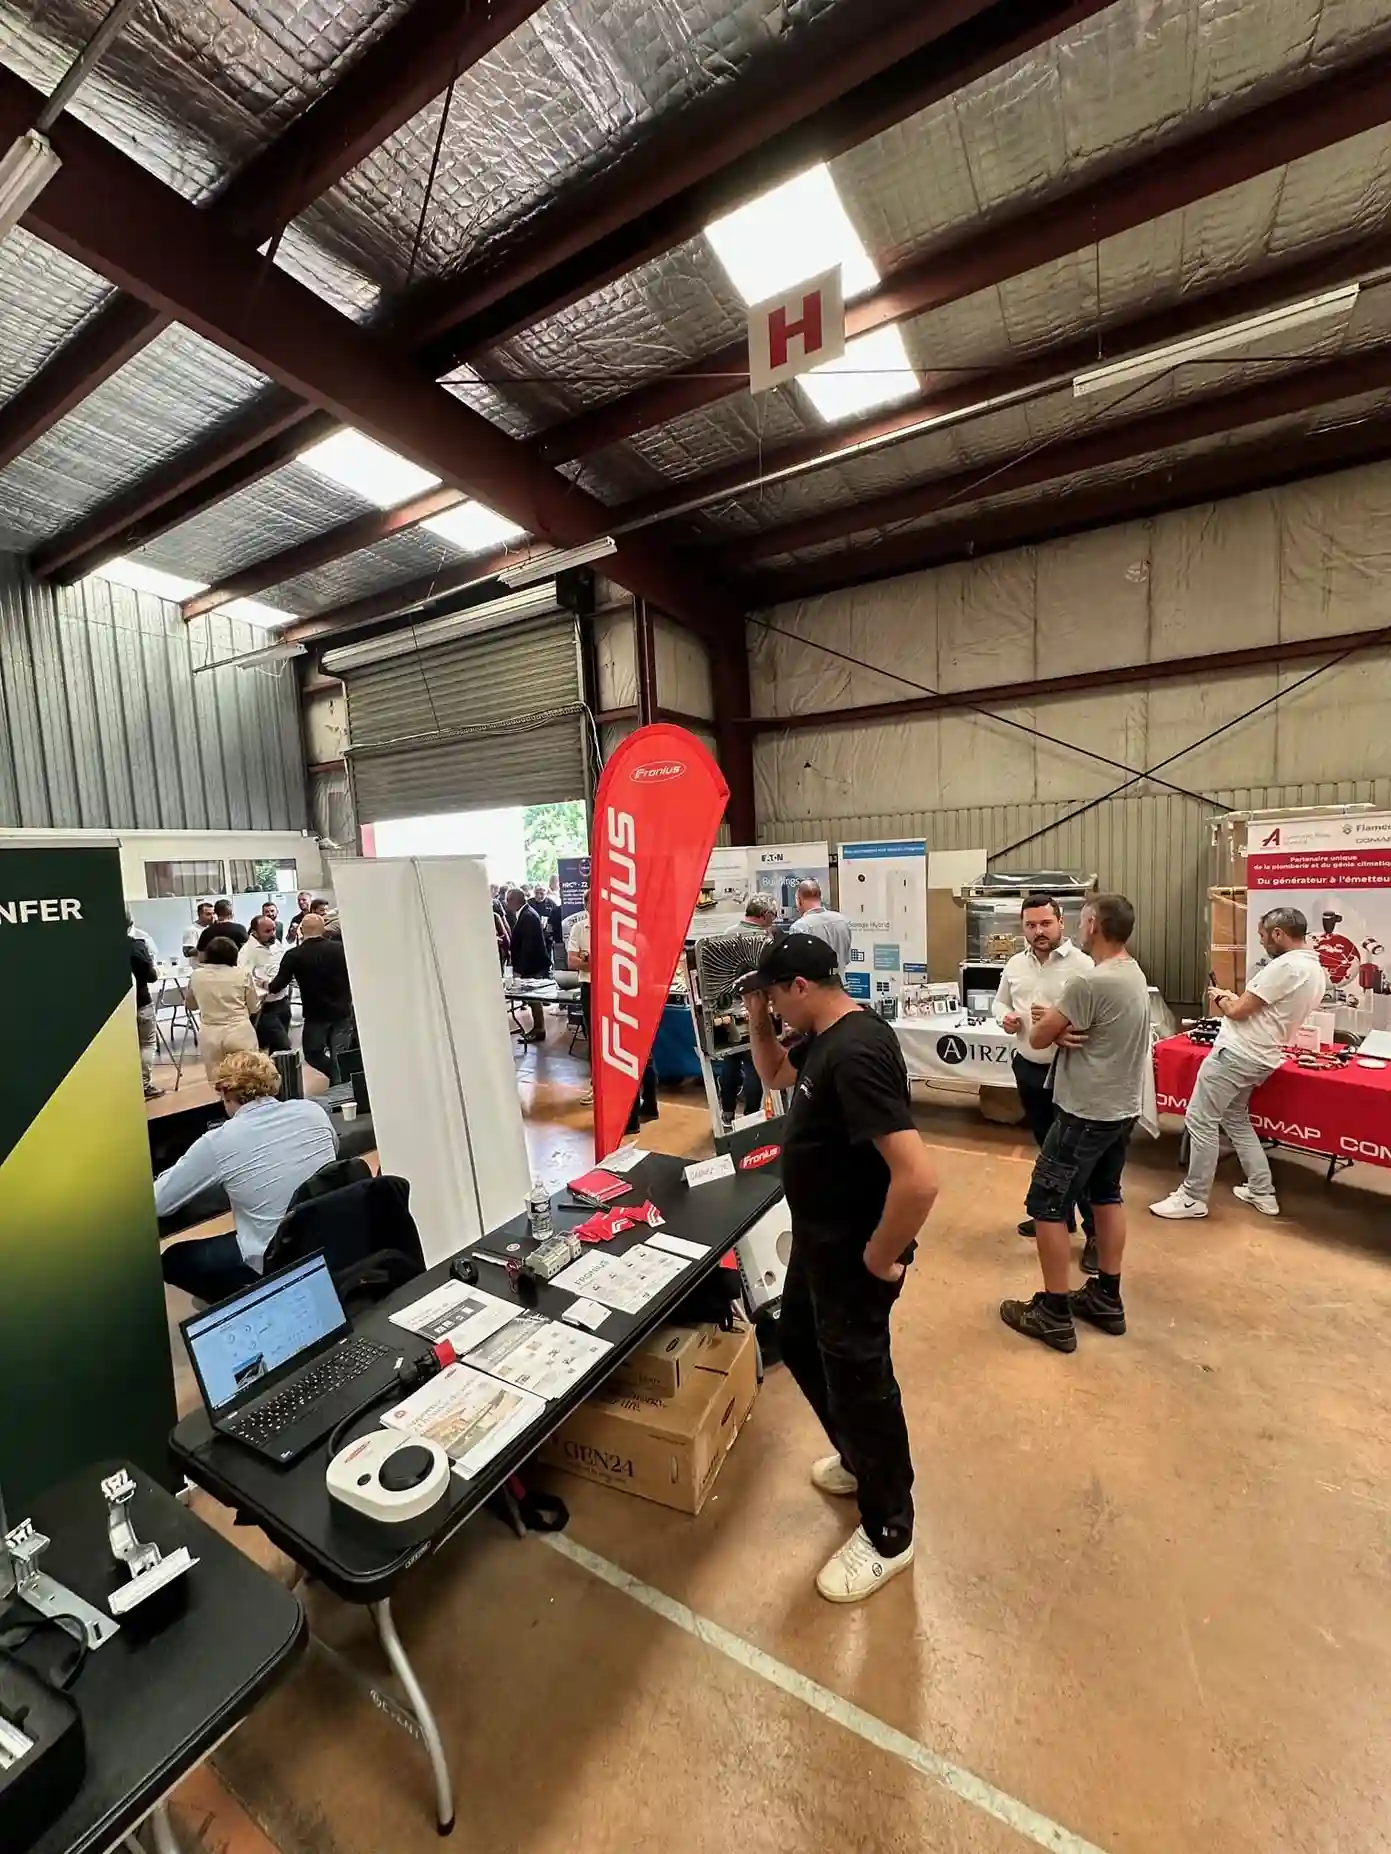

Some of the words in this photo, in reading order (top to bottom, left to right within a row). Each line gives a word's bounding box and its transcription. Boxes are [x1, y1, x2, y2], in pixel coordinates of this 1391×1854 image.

[768, 289, 823, 369] H
[634, 765, 682, 780] Fronius
[1272, 863, 1309, 871] plomberie
[1332, 861, 1355, 869] génie
[1272, 876, 1327, 886] générateur
[1329, 875, 1336, 883] à
[0, 898, 84, 925] NFER
[601, 806, 640, 1081] Fronius
[942, 1037, 1017, 1063] AIRZ
[1249, 1113, 1322, 1139] OMAP
[742, 1147, 779, 1169] Fronius
[563, 1440, 634, 1477] GEN24
